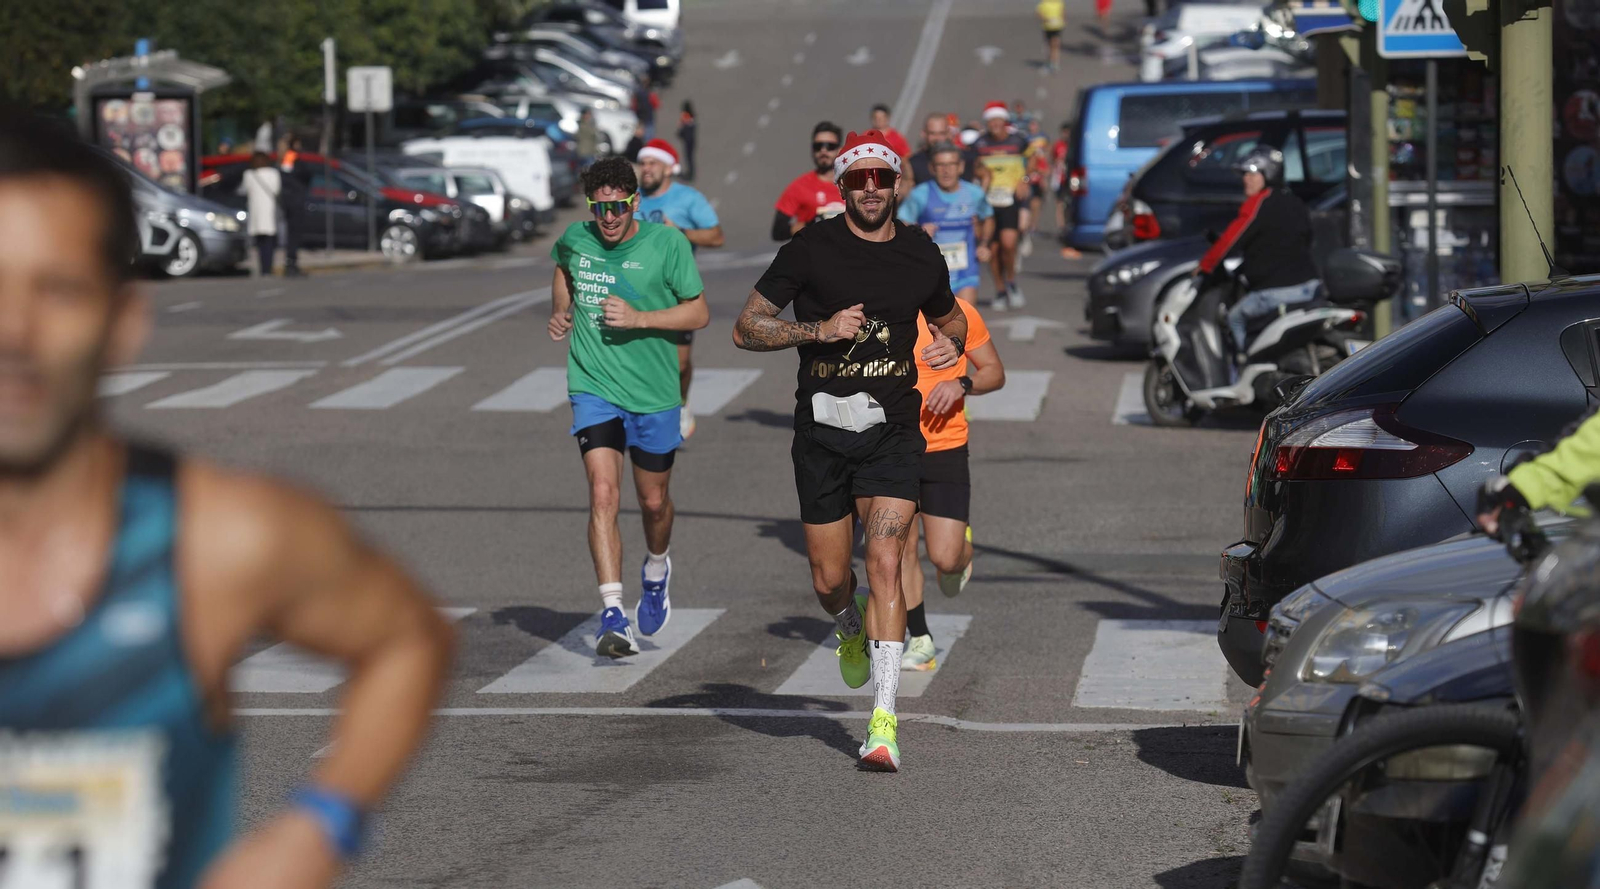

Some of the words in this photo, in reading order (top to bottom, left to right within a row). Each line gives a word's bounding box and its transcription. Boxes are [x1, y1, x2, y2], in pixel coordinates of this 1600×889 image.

[579, 256, 591, 268] En
[578, 271, 616, 284] marcha
[576, 281, 609, 294] contra
